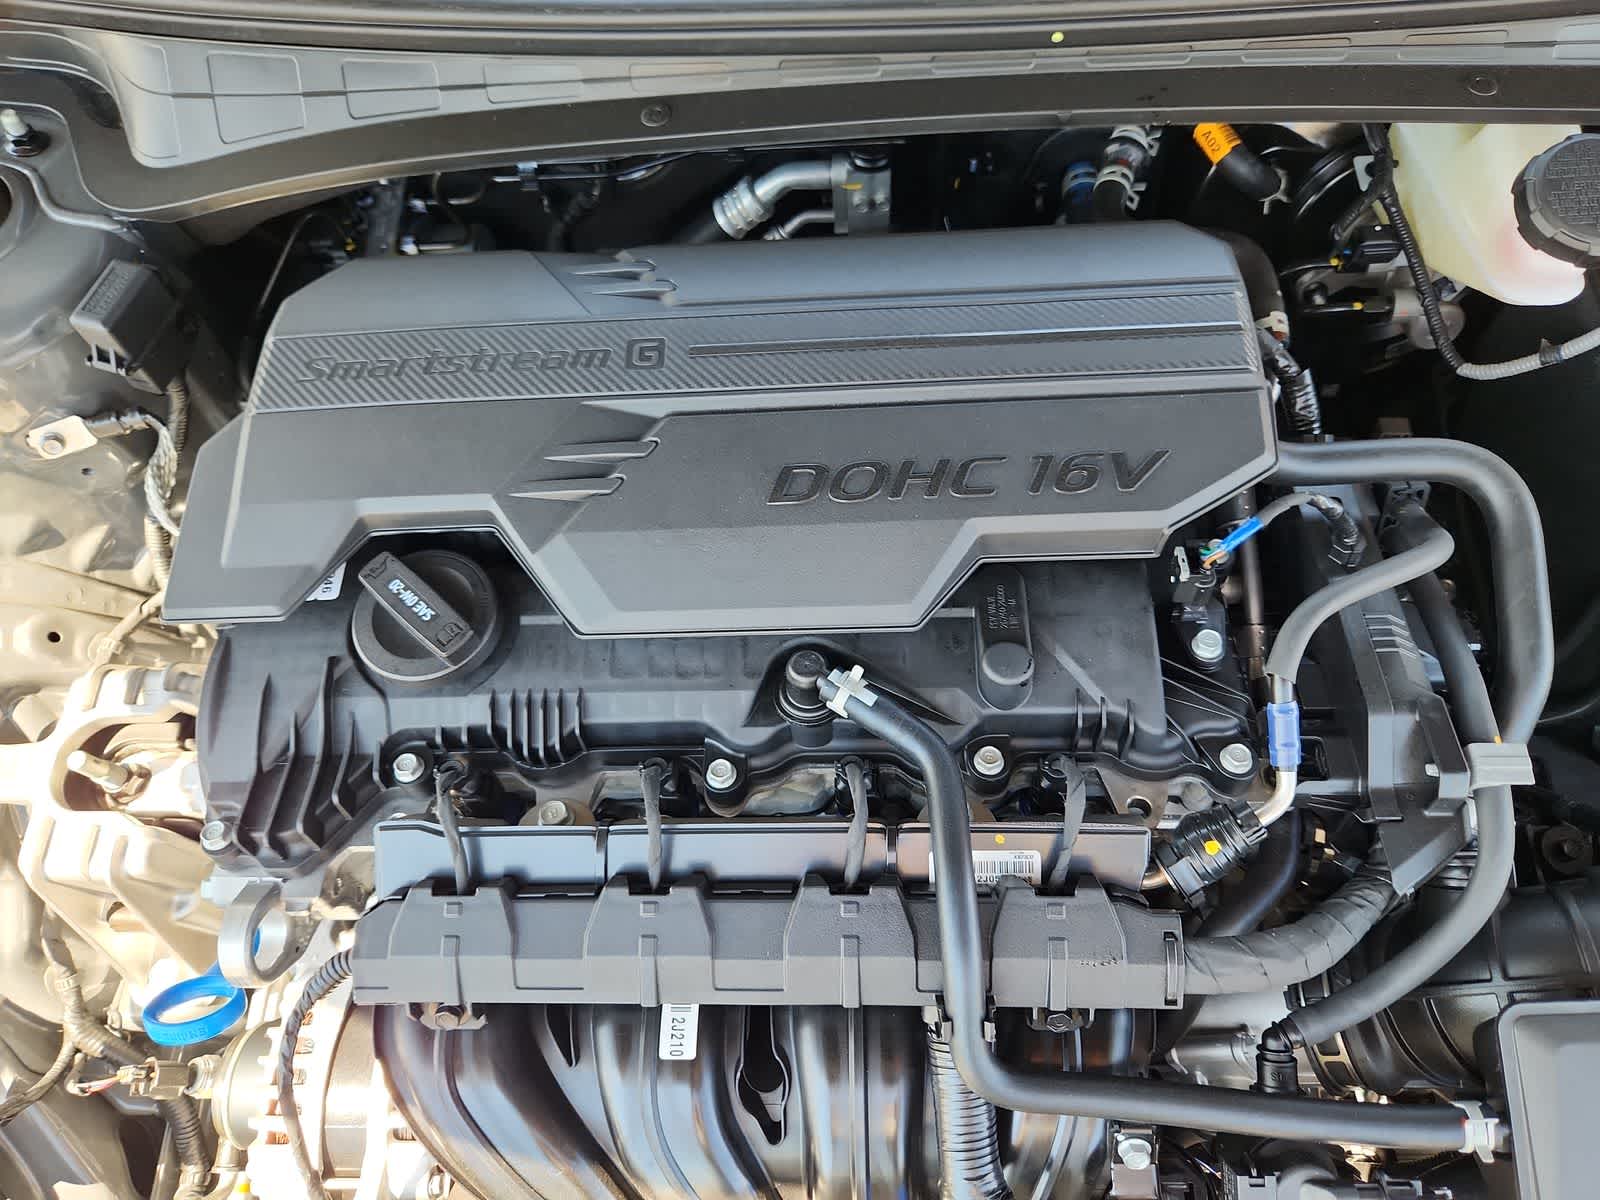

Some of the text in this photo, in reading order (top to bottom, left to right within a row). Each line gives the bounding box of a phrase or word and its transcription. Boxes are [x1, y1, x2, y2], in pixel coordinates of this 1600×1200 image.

[296, 346, 613, 383] Smartstream
[766, 449, 1172, 505] DOHC 16V
[388, 578, 436, 621] SAE 0W-20
[670, 1017, 686, 1057] 2J210
